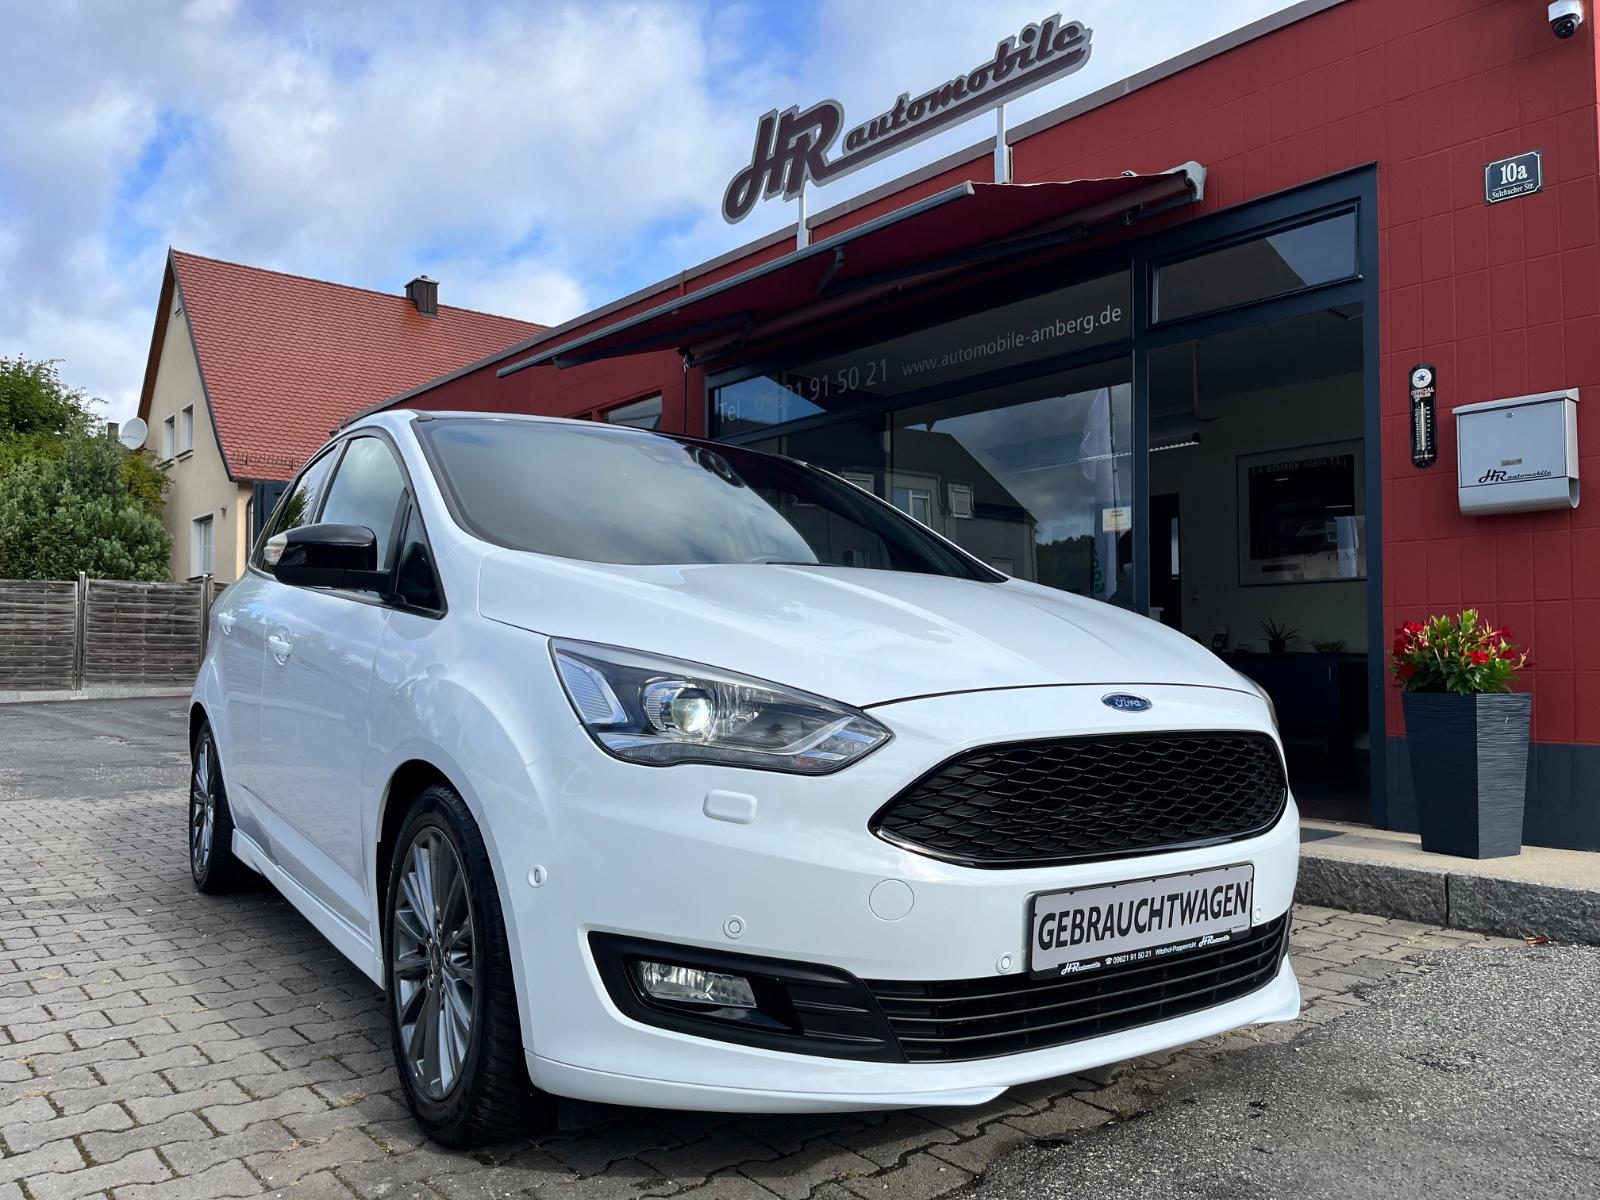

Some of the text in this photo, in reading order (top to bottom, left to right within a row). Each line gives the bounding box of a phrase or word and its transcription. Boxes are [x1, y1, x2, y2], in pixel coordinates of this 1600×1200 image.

[723, 14, 1092, 223] HR automobile
[1501, 163, 1527, 184] 10a
[902, 304, 1122, 376] www.automobile-amberg.de
[810, 374, 828, 400] 91
[838, 366, 859, 394] 50
[866, 359, 886, 386] 21
[1478, 469, 1507, 483] HR
[1038, 881, 1250, 951] GEBRAUCHTWAGEN
